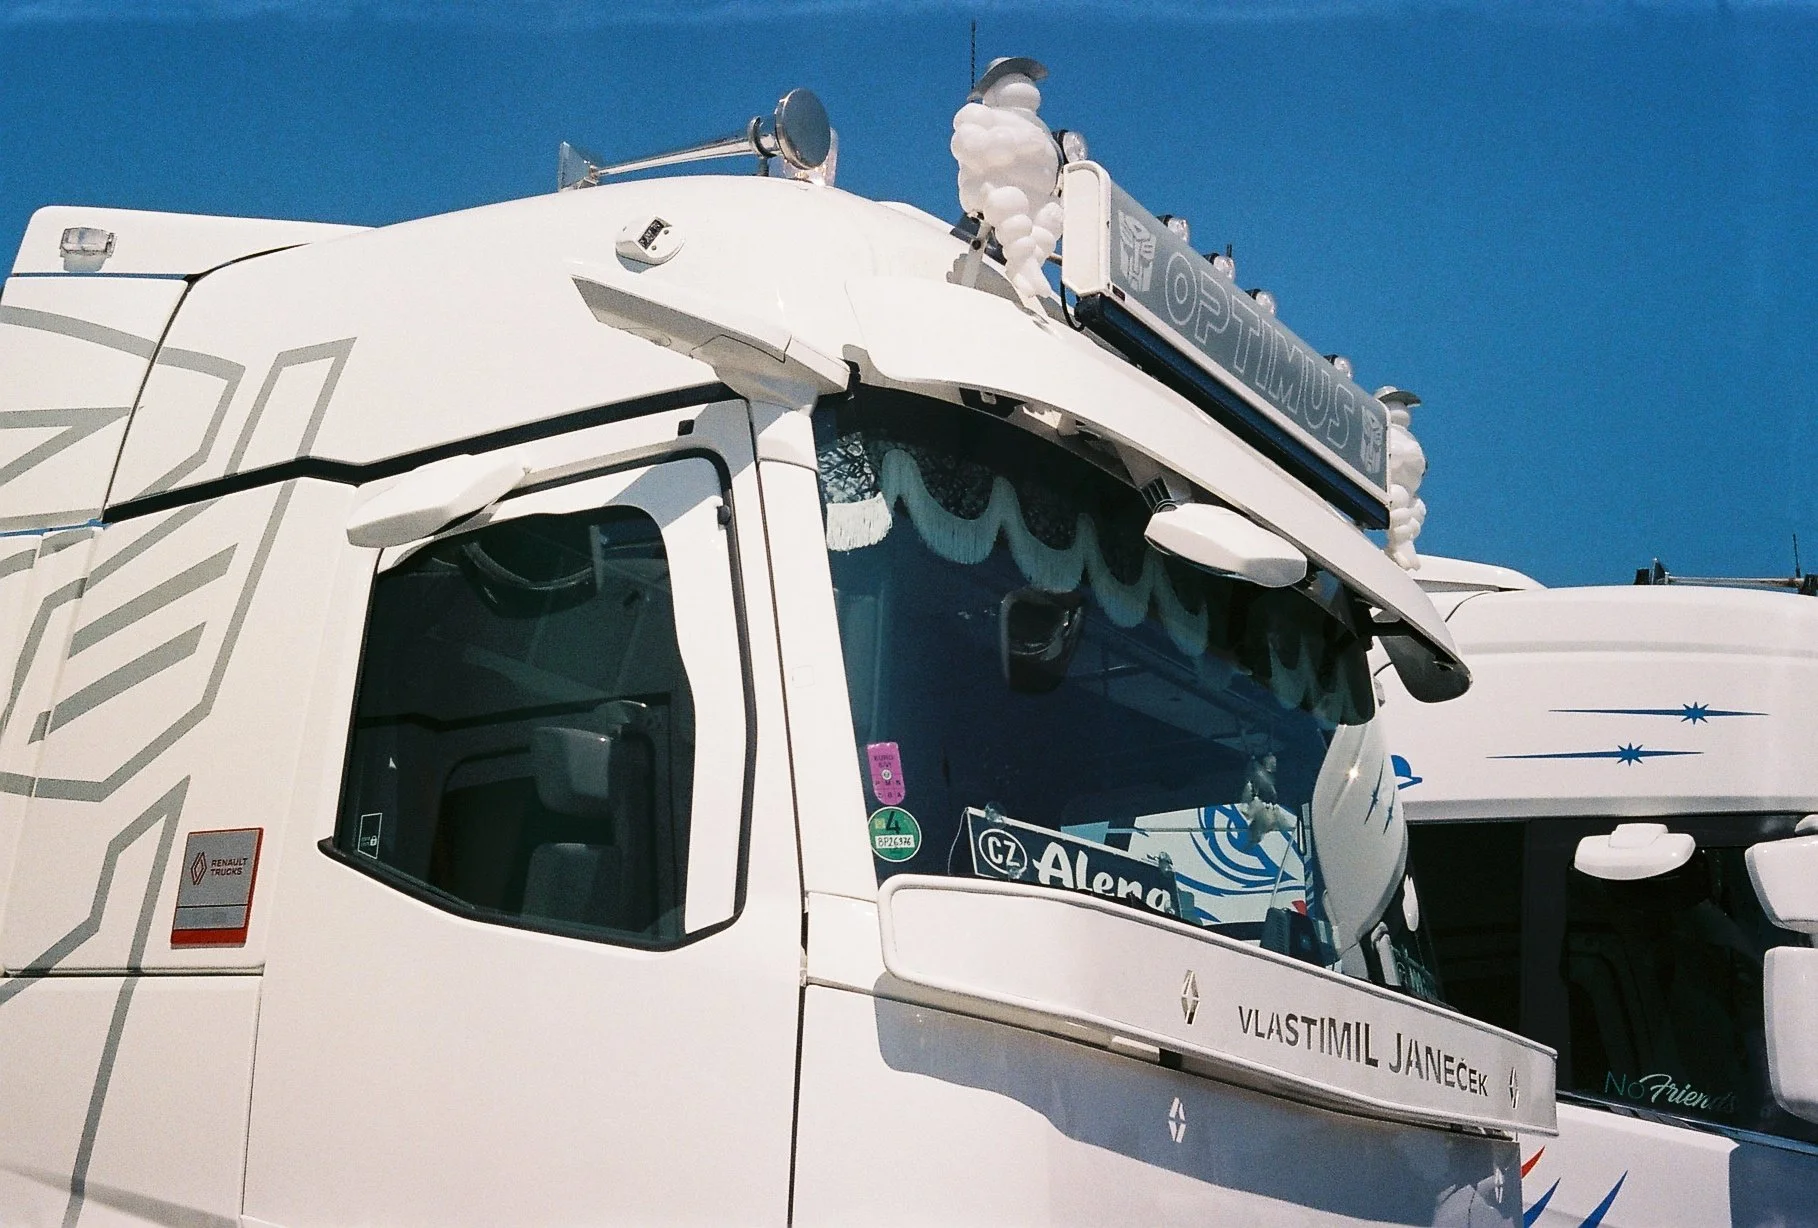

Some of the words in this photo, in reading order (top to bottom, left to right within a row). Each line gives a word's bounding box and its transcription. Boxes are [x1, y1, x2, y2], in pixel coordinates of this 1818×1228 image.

[1164, 251, 1355, 450] OPTIMUS
[886, 811, 901, 835] 4
[211, 858, 248, 867] RENAULT
[211, 867, 243, 876] TRUCKS
[987, 836, 1021, 868] CZ
[1032, 841, 1173, 913] Alena
[1238, 1005, 1380, 1068] VLASTIMIL
[1388, 1032, 1489, 1098] JANEČEK
[1604, 1070, 1645, 1099] No
